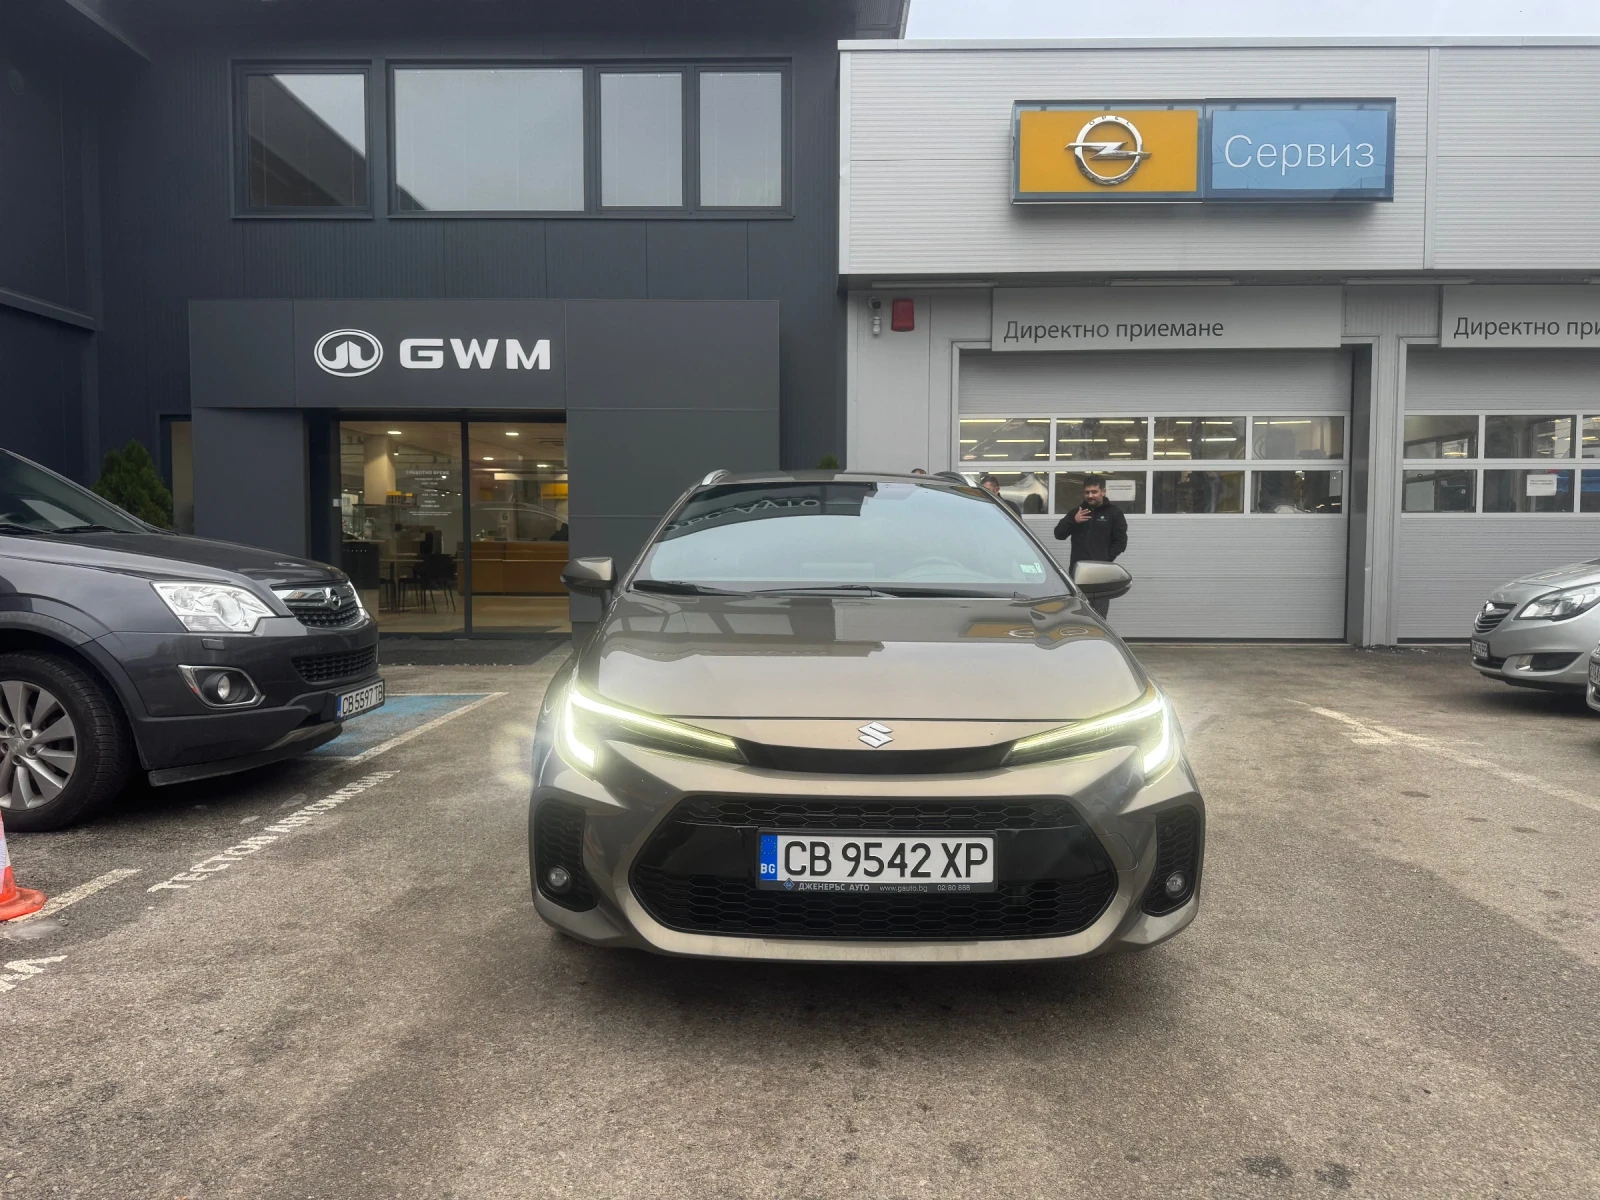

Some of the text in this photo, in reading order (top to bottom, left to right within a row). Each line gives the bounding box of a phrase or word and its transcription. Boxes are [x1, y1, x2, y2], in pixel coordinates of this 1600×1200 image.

[1088, 115, 1131, 127] OPEL
[1224, 134, 1375, 176] Сервиз
[1003, 320, 1224, 343] Директно приемане
[1453, 317, 1560, 340] Директно
[399, 337, 551, 371] GWM
[355, 688, 373, 710] 5597
[760, 863, 776, 875] BG
[784, 840, 988, 879] CB 9542 XP
[798, 882, 846, 891] ДЖЕНЕРЪС
[849, 883, 870, 892] АУТО
[879, 884, 928, 893] www.gauto.bg
